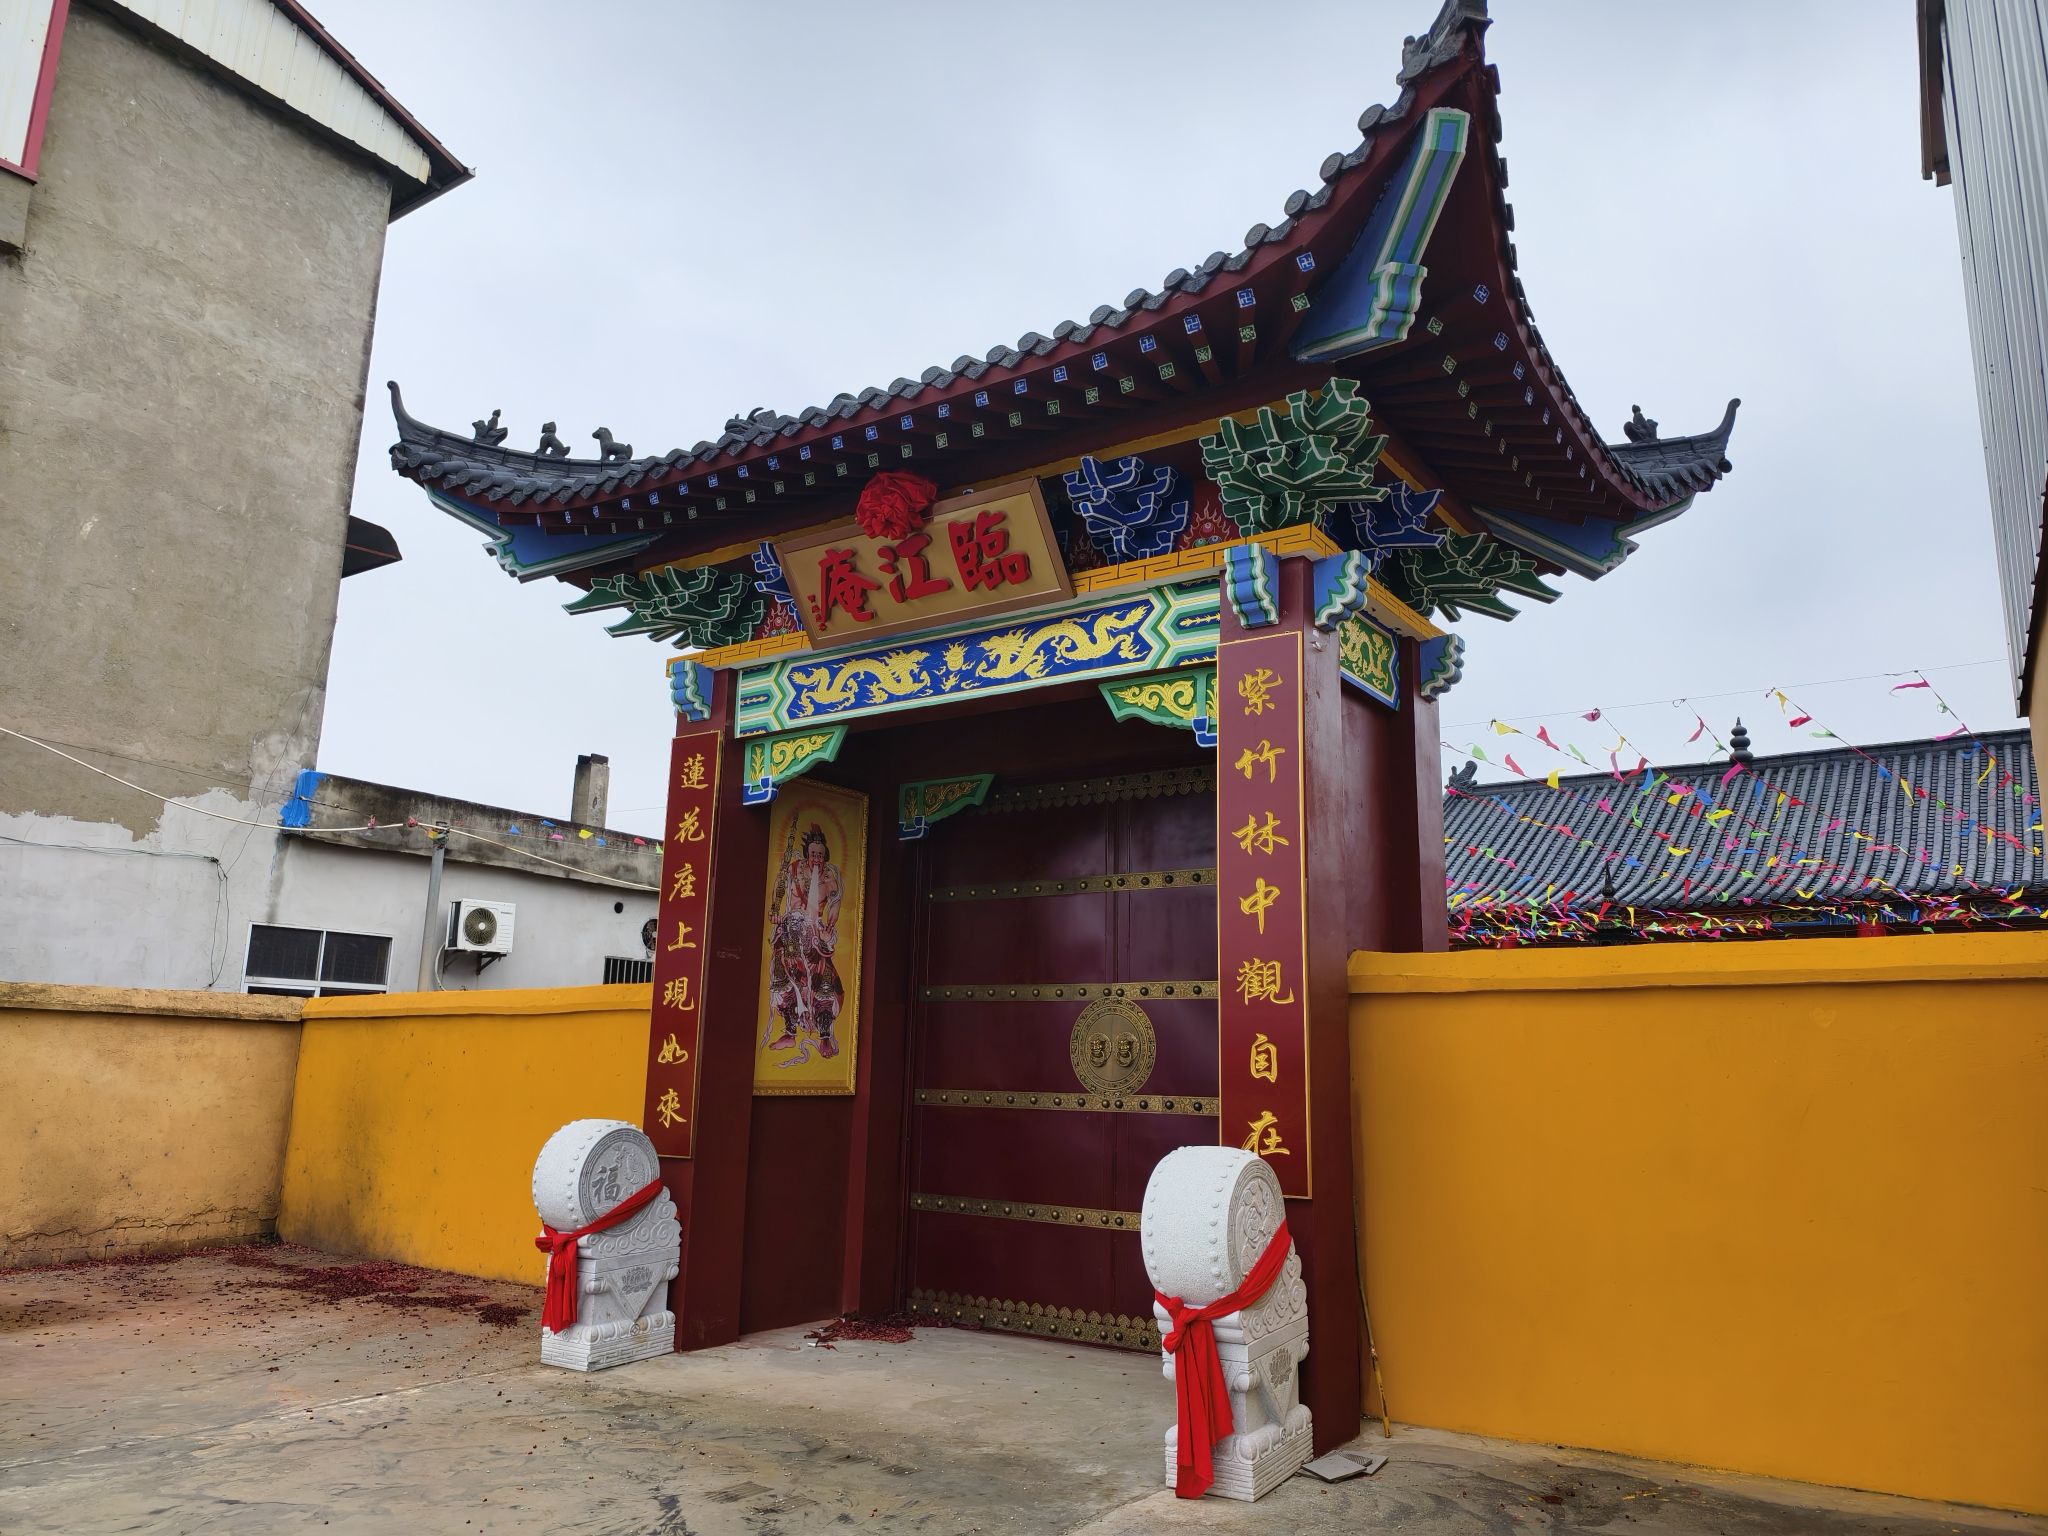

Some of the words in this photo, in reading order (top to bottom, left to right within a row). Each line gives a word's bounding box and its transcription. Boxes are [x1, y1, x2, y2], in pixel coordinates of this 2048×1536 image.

[657, 753, 709, 1128] 蓮花座上現如來
[1232, 668, 1294, 1155] 紫竹林中觀自在
[592, 1165, 620, 1203] 福
